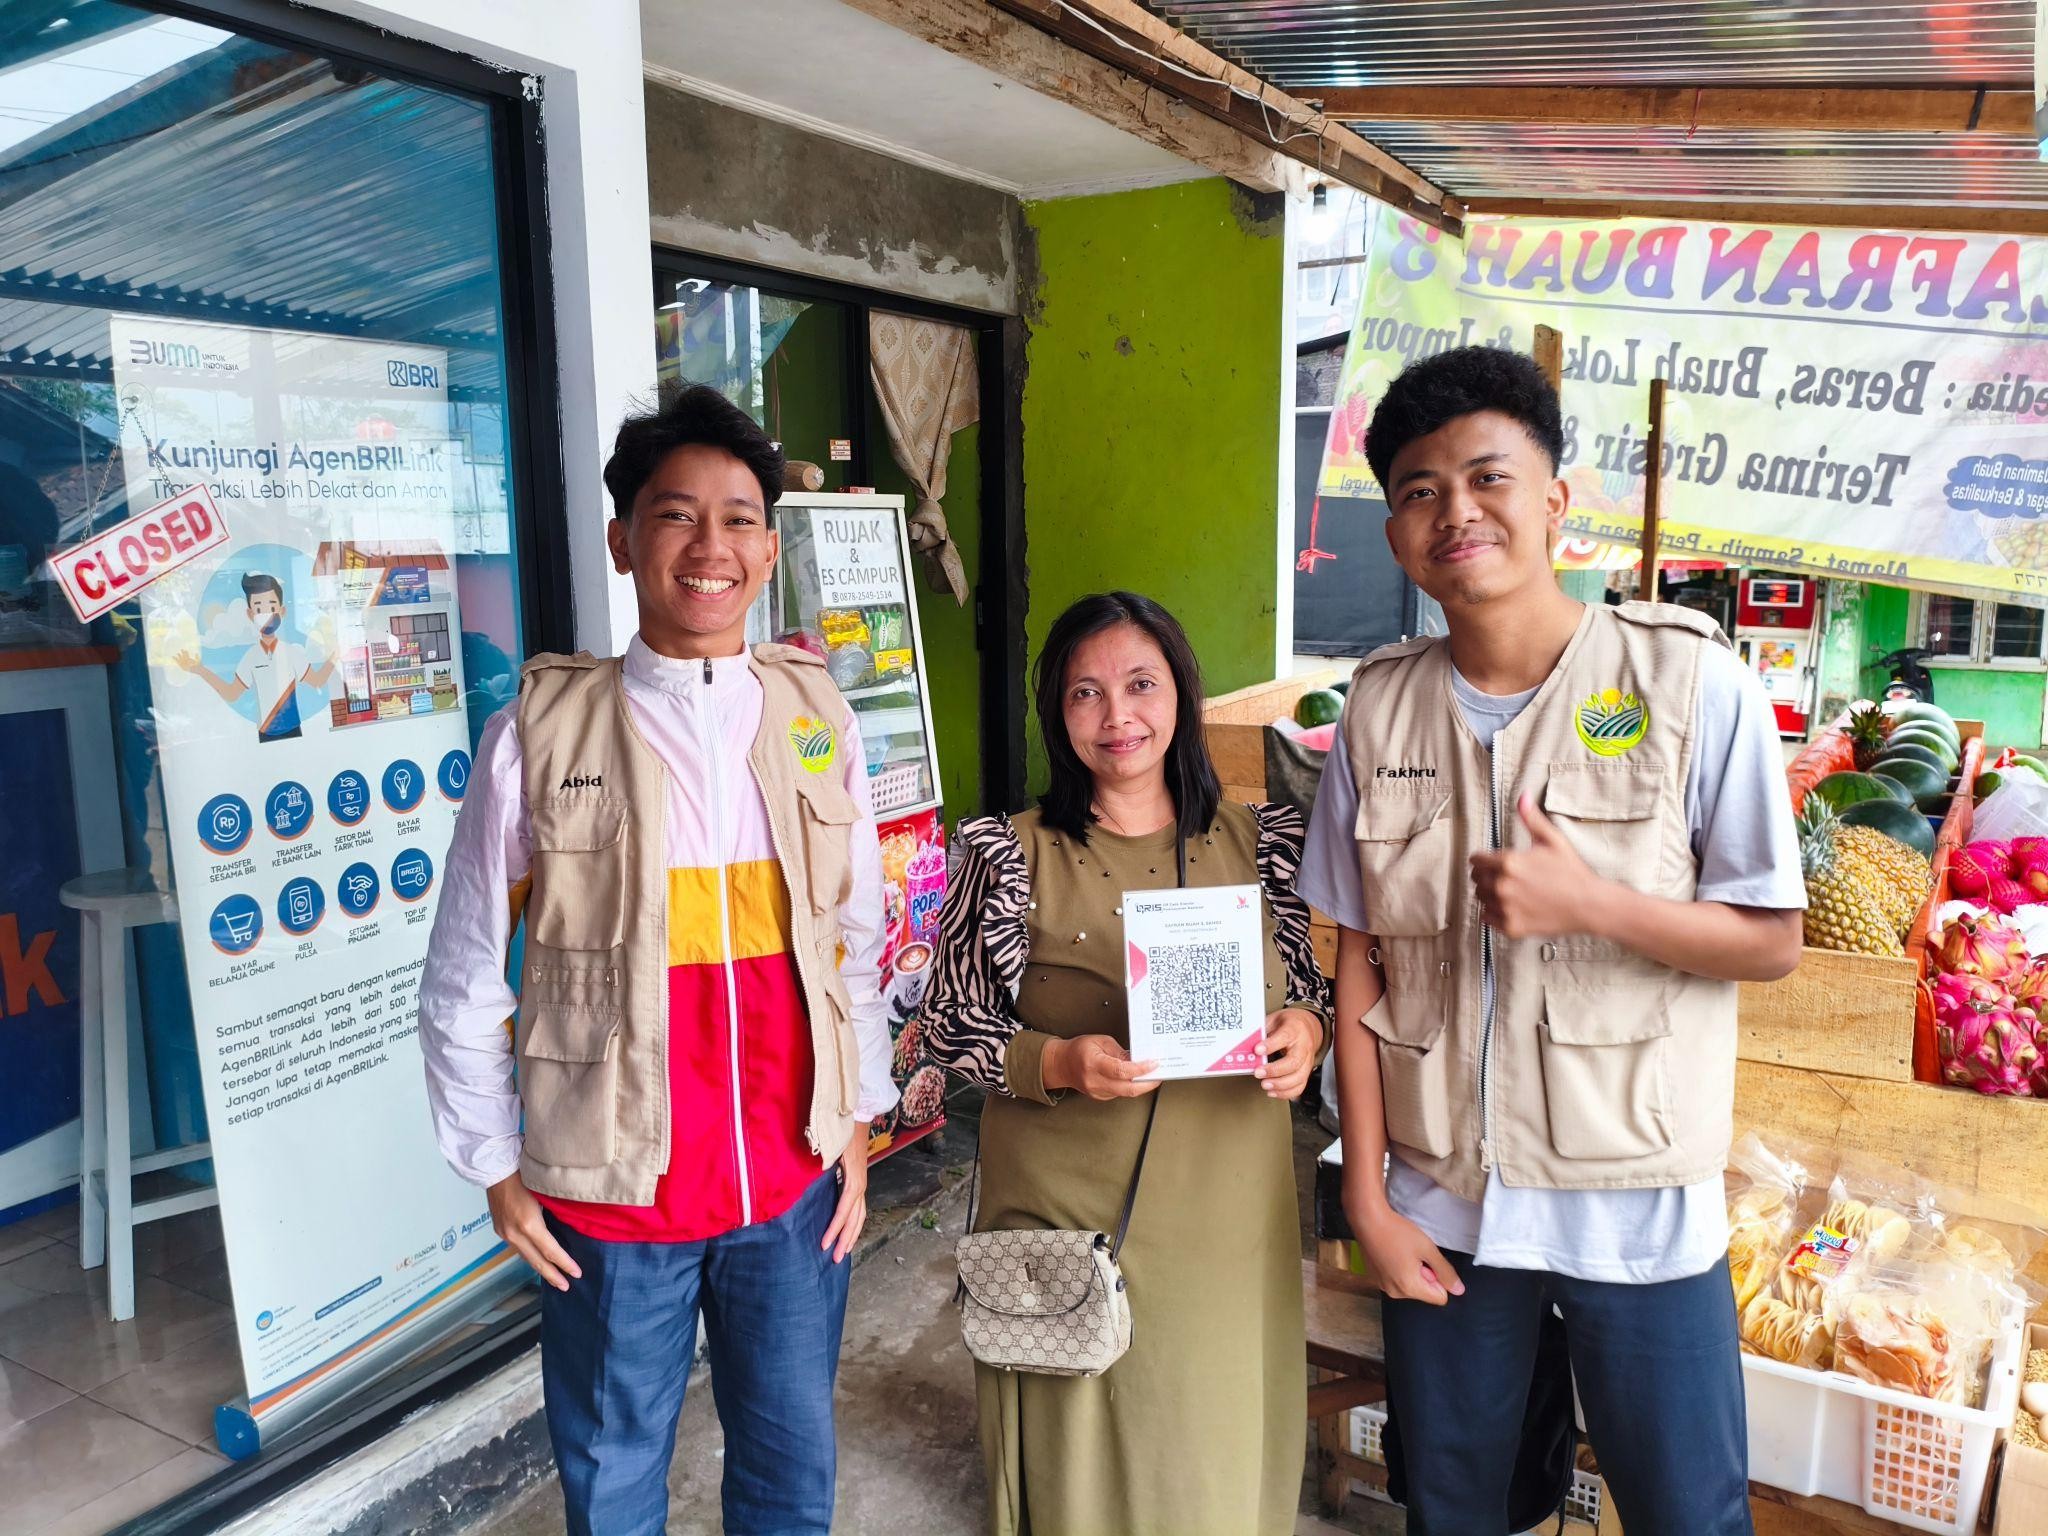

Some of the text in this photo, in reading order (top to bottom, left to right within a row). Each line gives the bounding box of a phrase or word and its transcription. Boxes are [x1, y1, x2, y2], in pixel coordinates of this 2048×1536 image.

[201, 353, 226, 363] UNTUK
[203, 361, 240, 372] INDONESIA
[408, 363, 439, 389] BRI
[147, 438, 444, 477] Kunjungi AgenBRILink
[148, 478, 447, 500] Traaksi Lebih Dekat dan Aman
[823, 520, 882, 544] RUJAK
[74, 501, 213, 601] CLOSED
[849, 547, 860, 564] &
[821, 568, 835, 586] ES
[838, 566, 899, 586] CAMPUR
[1376, 767, 1436, 778] Fakhru
[560, 775, 602, 790] Abid
[219, 816, 236, 829] Rp
[397, 817, 420, 829] BAYAR
[397, 825, 421, 836] LISTRIK
[334, 837, 374, 852] TARIK TUNAI
[335, 829, 372, 845] SETOR DAN
[271, 848, 322, 868] KE BANK LAIN
[275, 843, 313, 858] TRANSFER
[209, 865, 257, 883] SESAMA BRI
[211, 858, 252, 874] TRANSFER
[401, 866, 421, 877] BRIZZI
[912, 891, 938, 917] POP
[1136, 903, 1162, 914] QRIS
[404, 906, 428, 919] TOP UP
[407, 914, 426, 926] BRIZZI
[921, 908, 940, 931] ES
[347, 929, 381, 945] PINJAMAN
[349, 921, 379, 937] SETORAN
[298, 941, 313, 952] BELI
[295, 949, 318, 961] PULSA
[0, 912, 68, 1019] k
[230, 960, 258, 974] BAYAR
[209, 961, 276, 988] BELANJA ONLINE
[216, 1015, 264, 1038] Sambut
[266, 996, 318, 1022] semangat
[320, 987, 345, 1003] baru
[347, 974, 384, 993] dengan
[219, 977, 417, 1056] semua transaksi yang lebih dekat
[221, 1040, 292, 1074] AgenBRILink
[301, 1029, 323, 1044] Ada
[331, 1016, 357, 1033] lebih
[364, 1004, 382, 1021] dari
[389, 995, 407, 1011] 500
[222, 1066, 272, 1091] tersebar
[275, 1058, 285, 1072] di
[288, 1045, 326, 1067] seluruh
[329, 1025, 377, 1051] Indonesia
[379, 1015, 403, 1034] yang
[225, 1024, 420, 1109] Jangan lupa tetap memakai maske
[227, 1105, 264, 1126] setiap
[266, 1082, 312, 1112] transaksi
[313, 1077, 324, 1092] di
